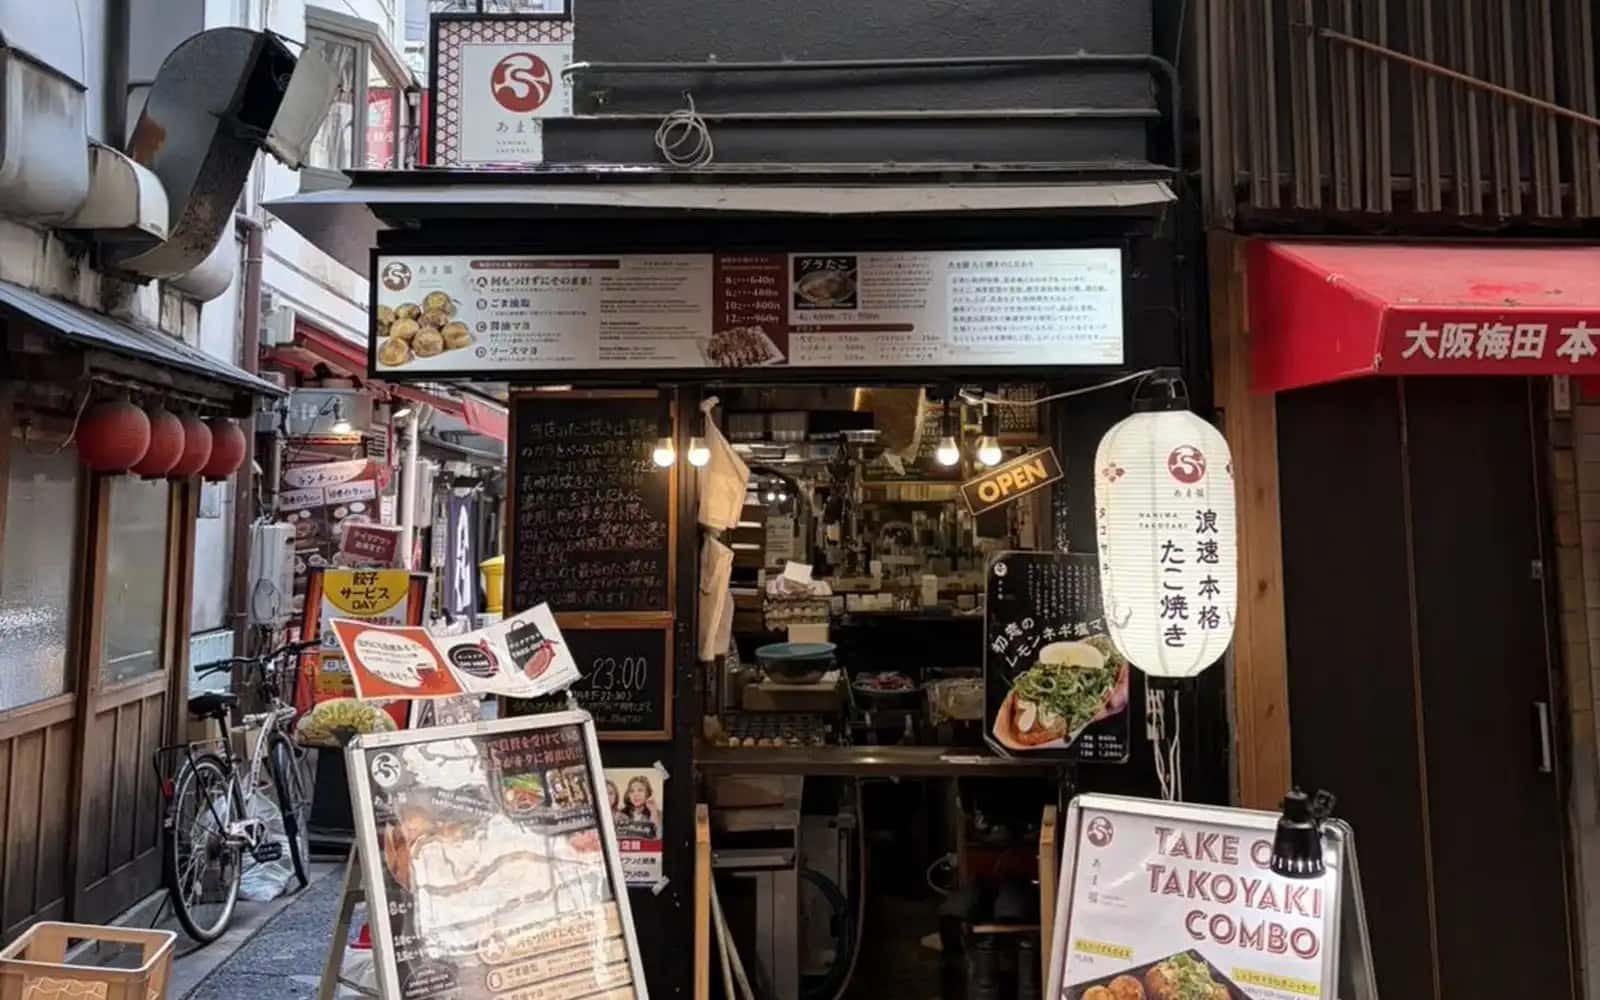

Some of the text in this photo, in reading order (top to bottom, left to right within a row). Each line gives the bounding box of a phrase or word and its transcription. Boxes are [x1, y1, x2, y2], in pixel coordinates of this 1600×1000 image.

[1402, 320, 1600, 364] 大阪梅田 本
[977, 457, 1048, 503] OPEN
[340, 587, 390, 600] サービス
[352, 600, 378, 610] DAY
[1160, 539, 1189, 648] たこ焼き
[1153, 825, 1241, 866] TAKE
[1145, 863, 1322, 919] TAKOYAKI
[1185, 909, 1321, 960] COMBO
